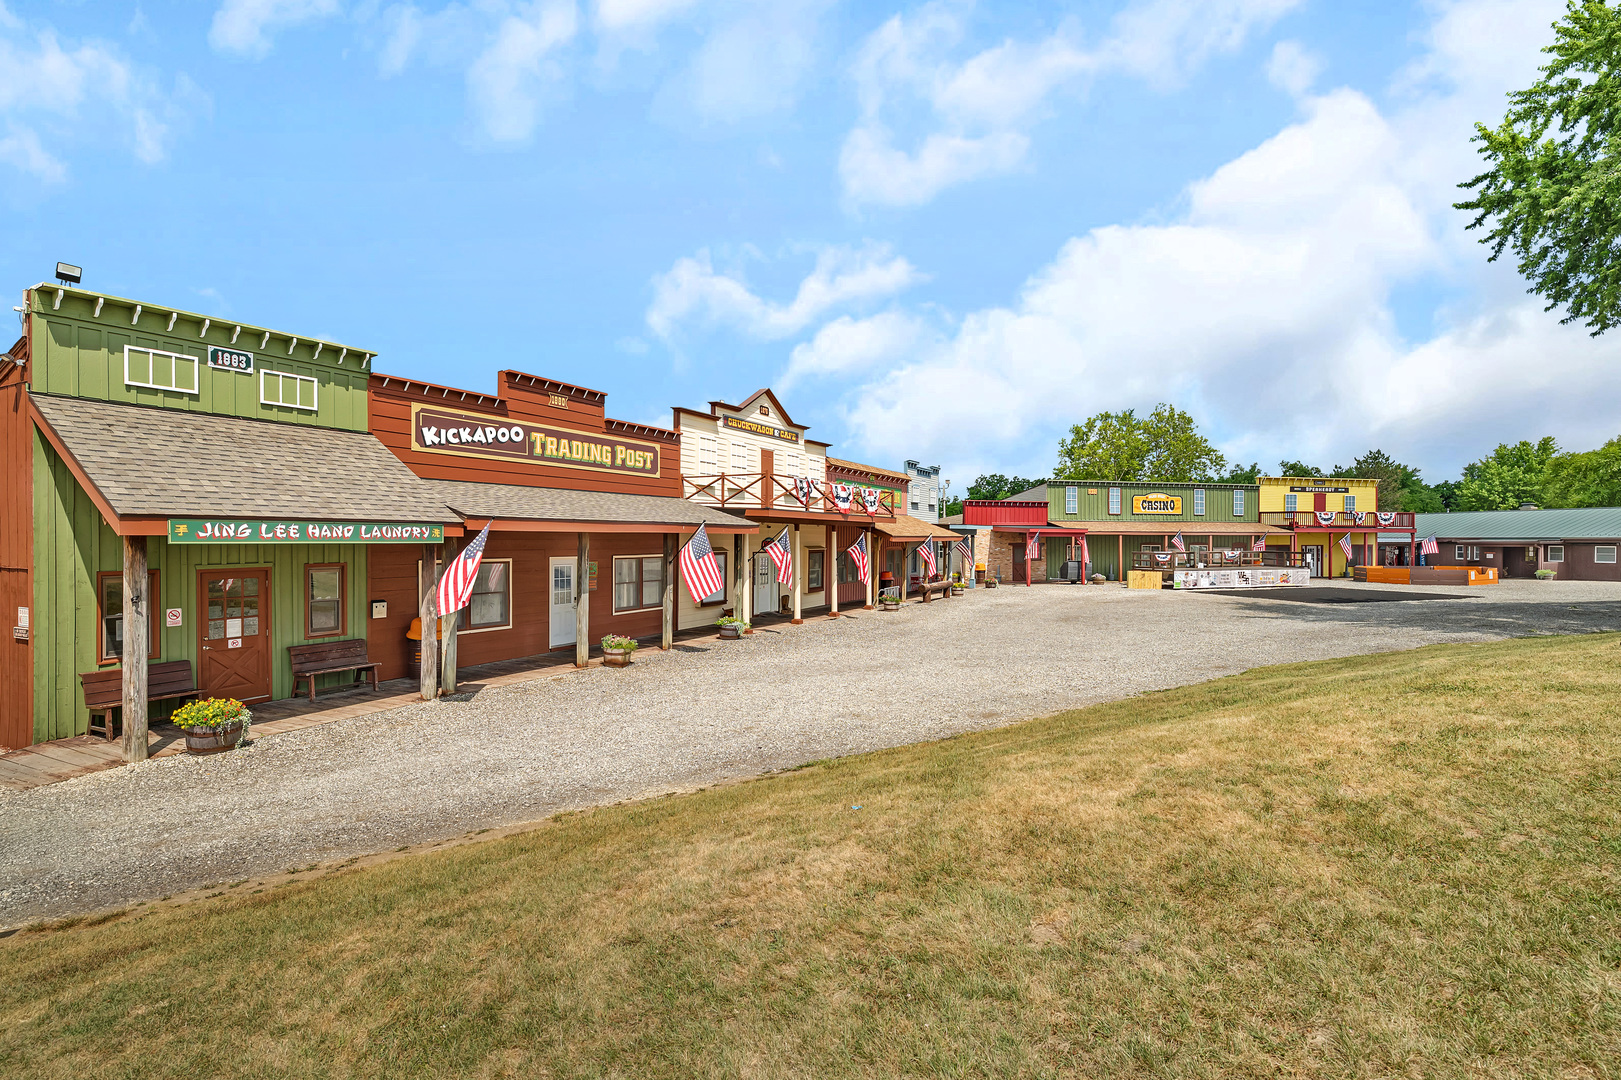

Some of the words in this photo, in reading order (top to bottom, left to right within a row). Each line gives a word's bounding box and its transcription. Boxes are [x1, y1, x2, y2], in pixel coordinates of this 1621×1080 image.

[217, 351, 246, 369] 1883
[728, 418, 774, 436] CHUCKWAGON
[421, 426, 524, 447] KICKAPOO
[530, 432, 612, 467] TRADING
[615, 445, 653, 470] POST
[1141, 499, 1175, 512] CASINO
[196, 522, 252, 539] JING
[259, 523, 300, 539] LEE
[306, 523, 354, 540] HAND
[360, 525, 430, 540] LAUNDRY
